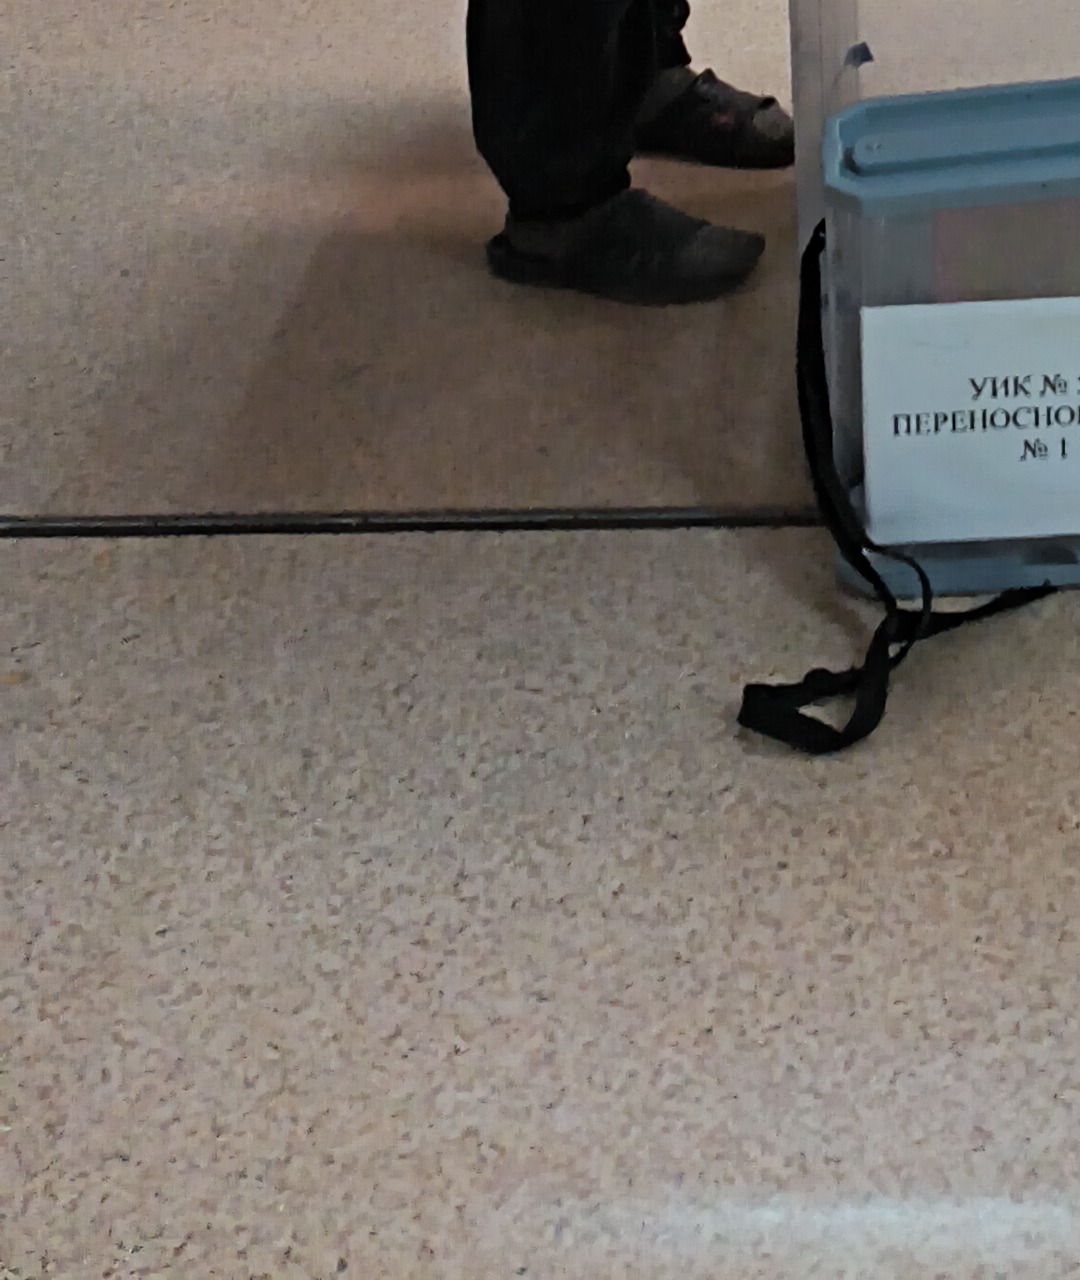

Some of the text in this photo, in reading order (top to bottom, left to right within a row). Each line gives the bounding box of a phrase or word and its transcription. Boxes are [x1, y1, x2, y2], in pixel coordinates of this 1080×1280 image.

[969, 374, 1033, 400] УИК
[1039, 373, 1068, 398] №
[1019, 437, 1067, 461] № 1
